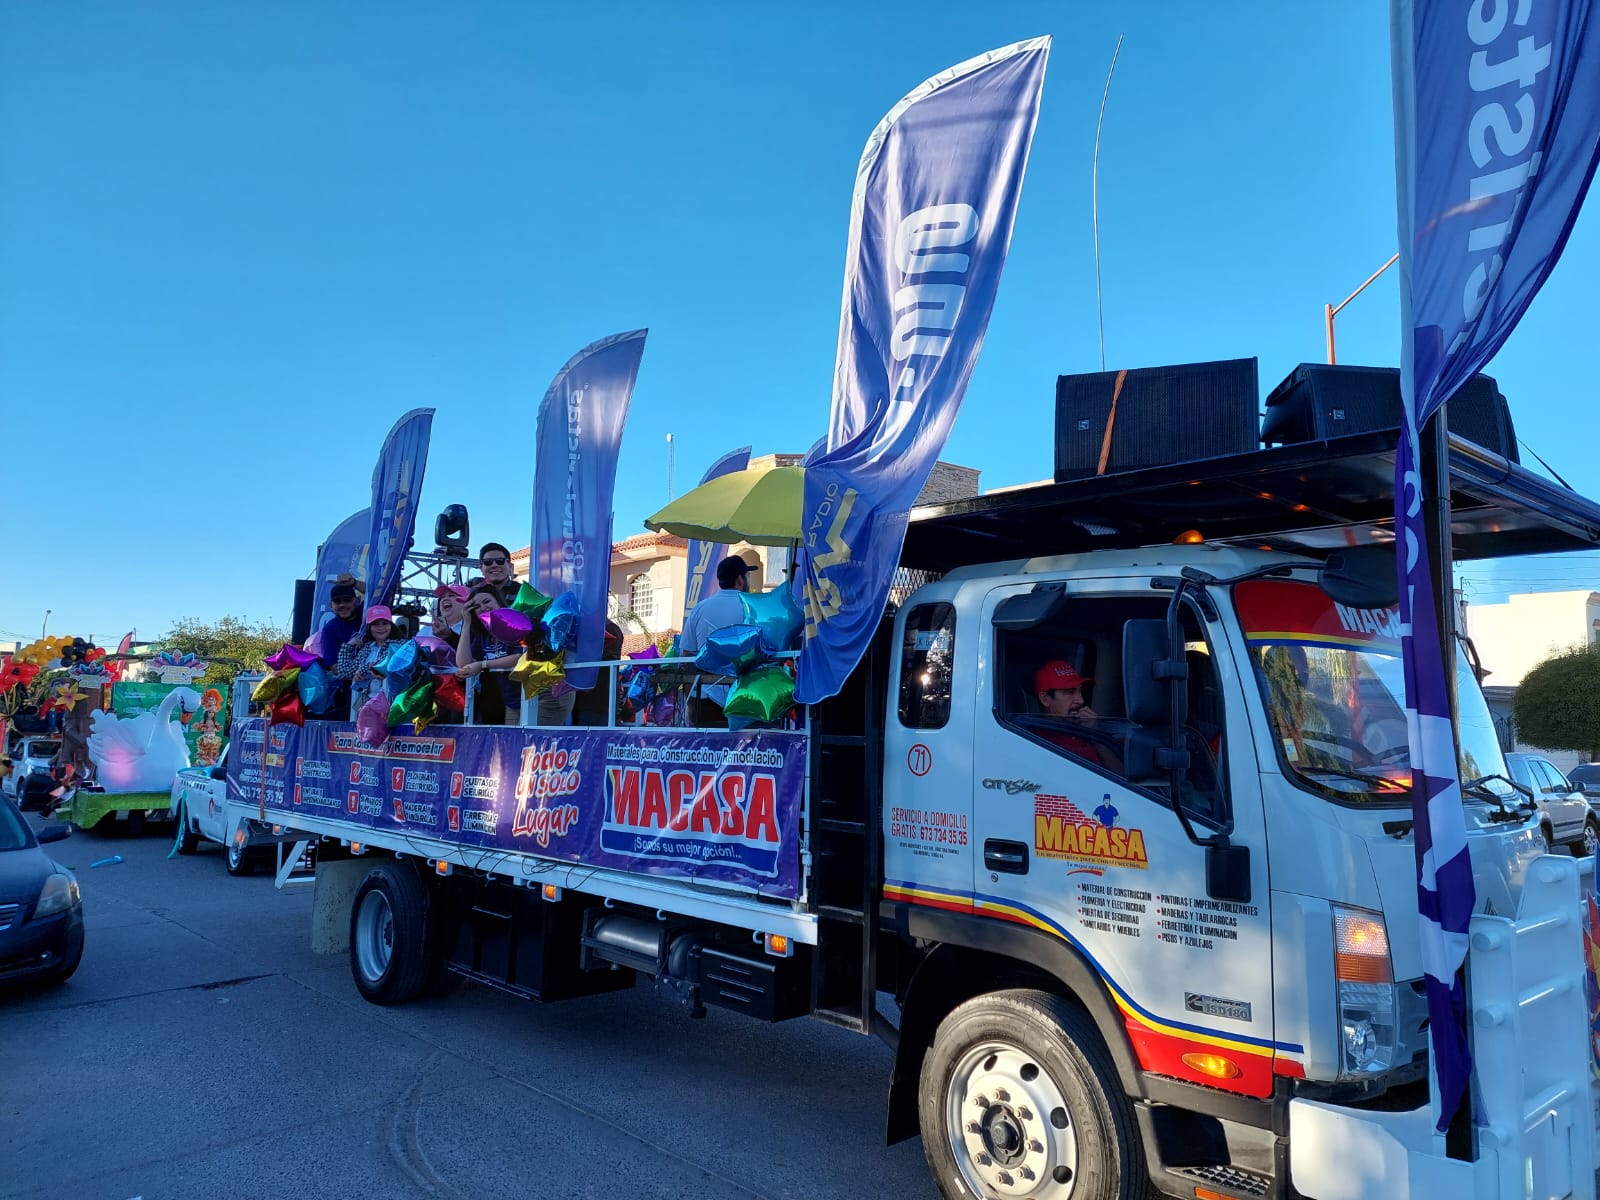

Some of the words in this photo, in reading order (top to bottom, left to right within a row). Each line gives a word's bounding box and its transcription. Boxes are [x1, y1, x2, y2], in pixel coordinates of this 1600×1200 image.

[607, 744, 640, 760] Materiales
[641, 748, 658, 764] para
[660, 747, 714, 764] Construcción
[714, 750, 722, 768] y
[914, 748, 926, 772] 71
[536, 770, 581, 798] SOLO
[513, 804, 579, 848] Lugar
[891, 807, 922, 825] SERVICIO
[924, 811, 929, 824] A
[931, 811, 967, 829] DOMICILIO
[891, 823, 917, 840] GRATIS
[920, 827, 933, 841] 673
[934, 828, 947, 843] 734
[948, 830, 957, 844] 35
[958, 831, 968, 846] 35
[1034, 814, 1148, 863] MACASA
[662, 842, 674, 853] su
[675, 841, 700, 857] mejor
[1081, 882, 1105, 895] MATERIAL
[1107, 886, 1113, 896] DE
[1081, 907, 1104, 919] PUERTAS
[1104, 911, 1111, 920] DE
[1111, 911, 1140, 925] SEGURIDAD
[1107, 899, 1111, 908] Y
[1111, 899, 1146, 913] ELECTRICIDAD
[1160, 894, 1188, 908] PINTURAS
[1193, 898, 1259, 917] IMPERMEABILIZANTES
[1161, 907, 1188, 920] MADERAS
[1190, 911, 1194, 921] Y
[1117, 925, 1140, 938] MUEBLES
[1161, 932, 1178, 944] PISOS
[1179, 935, 1184, 945] Y
[1184, 936, 1213, 950] AZULEJOS
